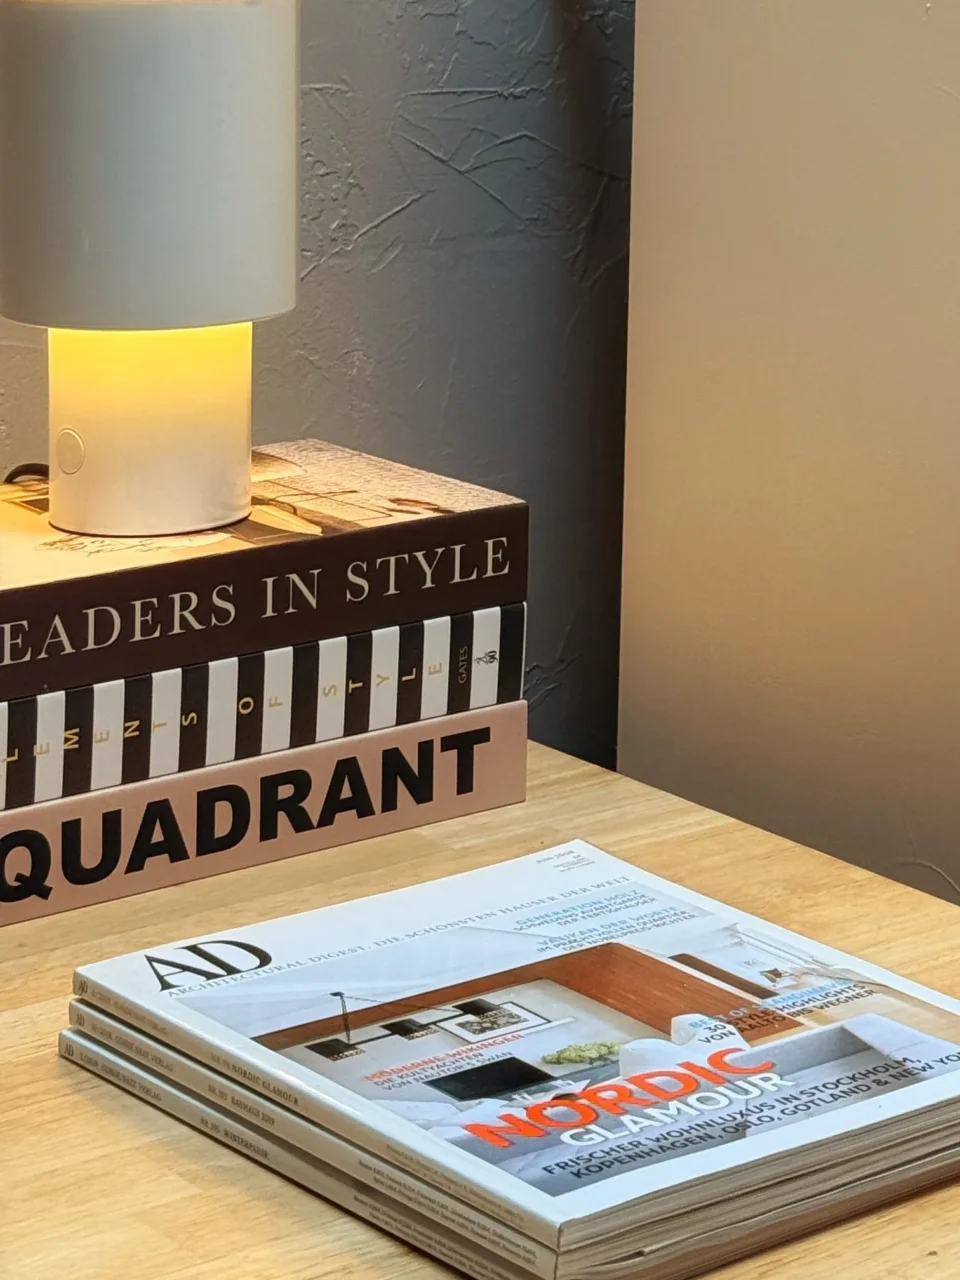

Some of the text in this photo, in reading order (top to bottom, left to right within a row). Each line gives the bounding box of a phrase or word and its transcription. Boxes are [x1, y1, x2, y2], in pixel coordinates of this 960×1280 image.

[260, 568, 323, 619] IN
[345, 536, 512, 604] STYLE
[457, 645, 469, 684] GATES
[0, 726, 492, 904] QUADRANT
[513, 894, 650, 932] SCHWEDENS AVANTGARDE
[515, 889, 642, 926] GENERATION HOLZ
[536, 906, 680, 946] VATIKAN DER WORTE
[556, 916, 581, 927] DER
[166, 959, 306, 999] ARCHITECTURAL
[373, 936, 404, 948] DIE
[405, 911, 498, 940] SCHÖNSTEN
[498, 894, 562, 917] HÄUSER
[561, 884, 592, 902] DER
[593, 875, 631, 892] WELT
[536, 910, 693, 956] IM PRACHTVOLLEN QUARTIER
[562, 941, 584, 954] DER
[144, 939, 273, 993] AD
[696, 989, 878, 1045] VON AALTO BIS WEGNER
[703, 1022, 728, 1035] 30
[364, 1032, 525, 1083] MODERNE WIKINGER
[373, 1051, 485, 1088] DIE KULTYACHTEN
[380, 1050, 515, 1094] VON NAUTOR'S SWAN
[231, 1062, 300, 1106] NORDIC GLAMOUR
[461, 1046, 777, 1152] NORDIC
[541, 1135, 647, 1180] FRISCHER
[644, 1099, 775, 1150] WOHNLUXUS
[774, 1093, 804, 1113] IN
[804, 1056, 923, 1104] STOCKHOLM,
[559, 1072, 796, 1148] GLAMOUR
[572, 1132, 725, 1185] KOPENHAGEN,
[724, 1112, 783, 1142] OSLO,
[783, 1081, 872, 1121] GOTLAND
[873, 1075, 891, 1090] &
[891, 1060, 934, 1086] NEW
